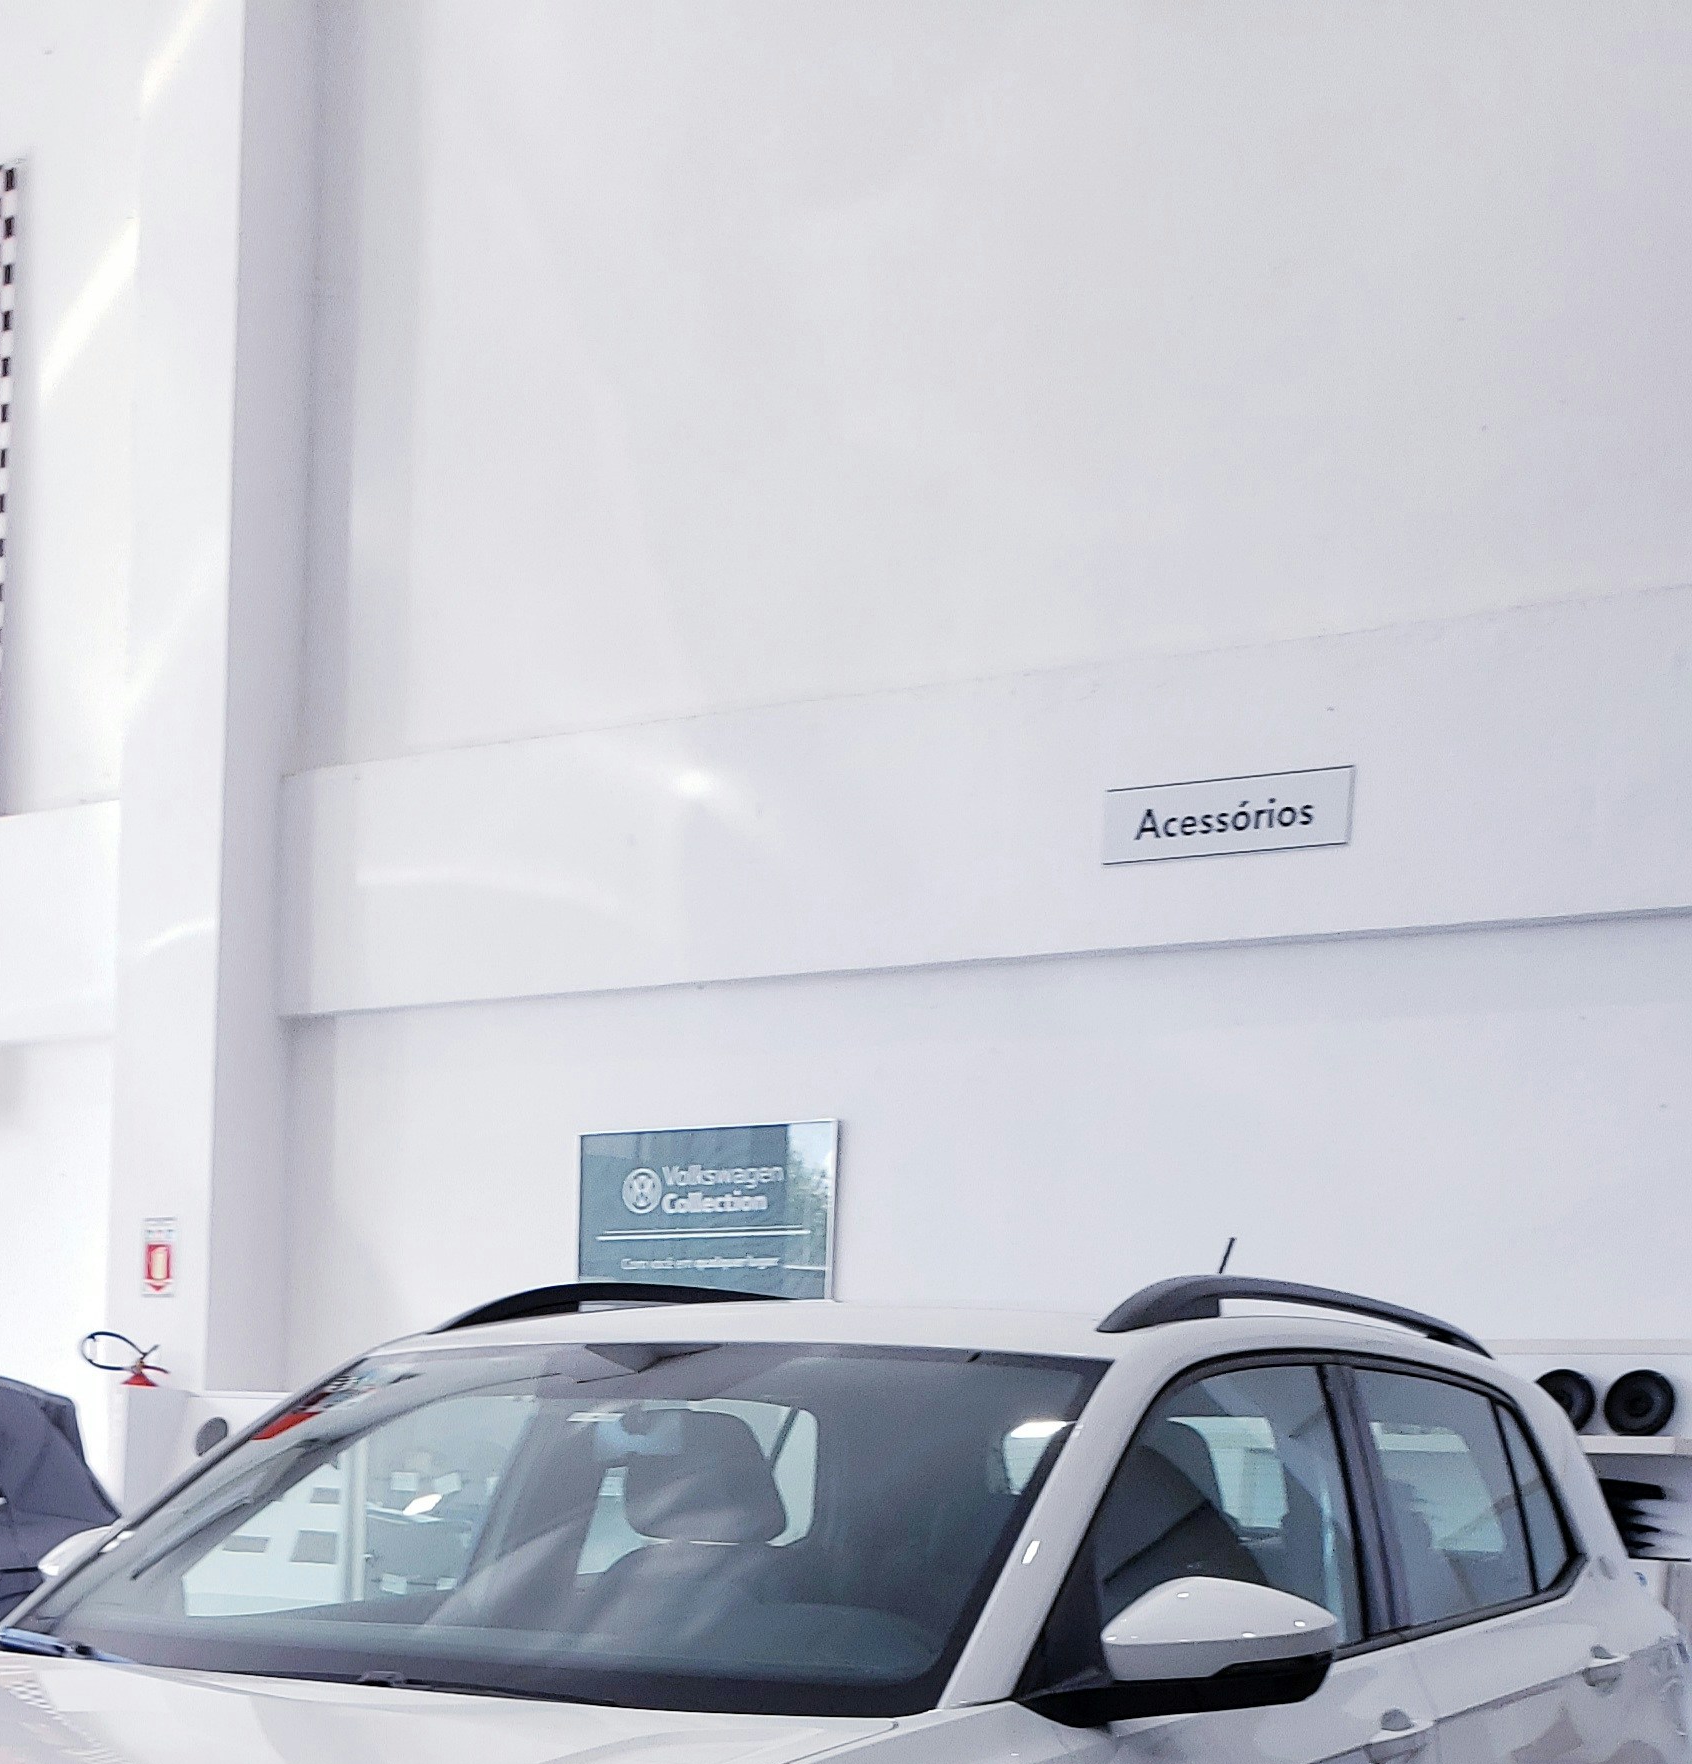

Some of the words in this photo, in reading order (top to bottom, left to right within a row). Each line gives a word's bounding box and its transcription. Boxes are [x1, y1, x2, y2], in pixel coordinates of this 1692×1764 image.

[1134, 798, 1315, 840] Acessórios
[662, 1164, 785, 1190] Volkswagen
[661, 1190, 768, 1215] Collection
